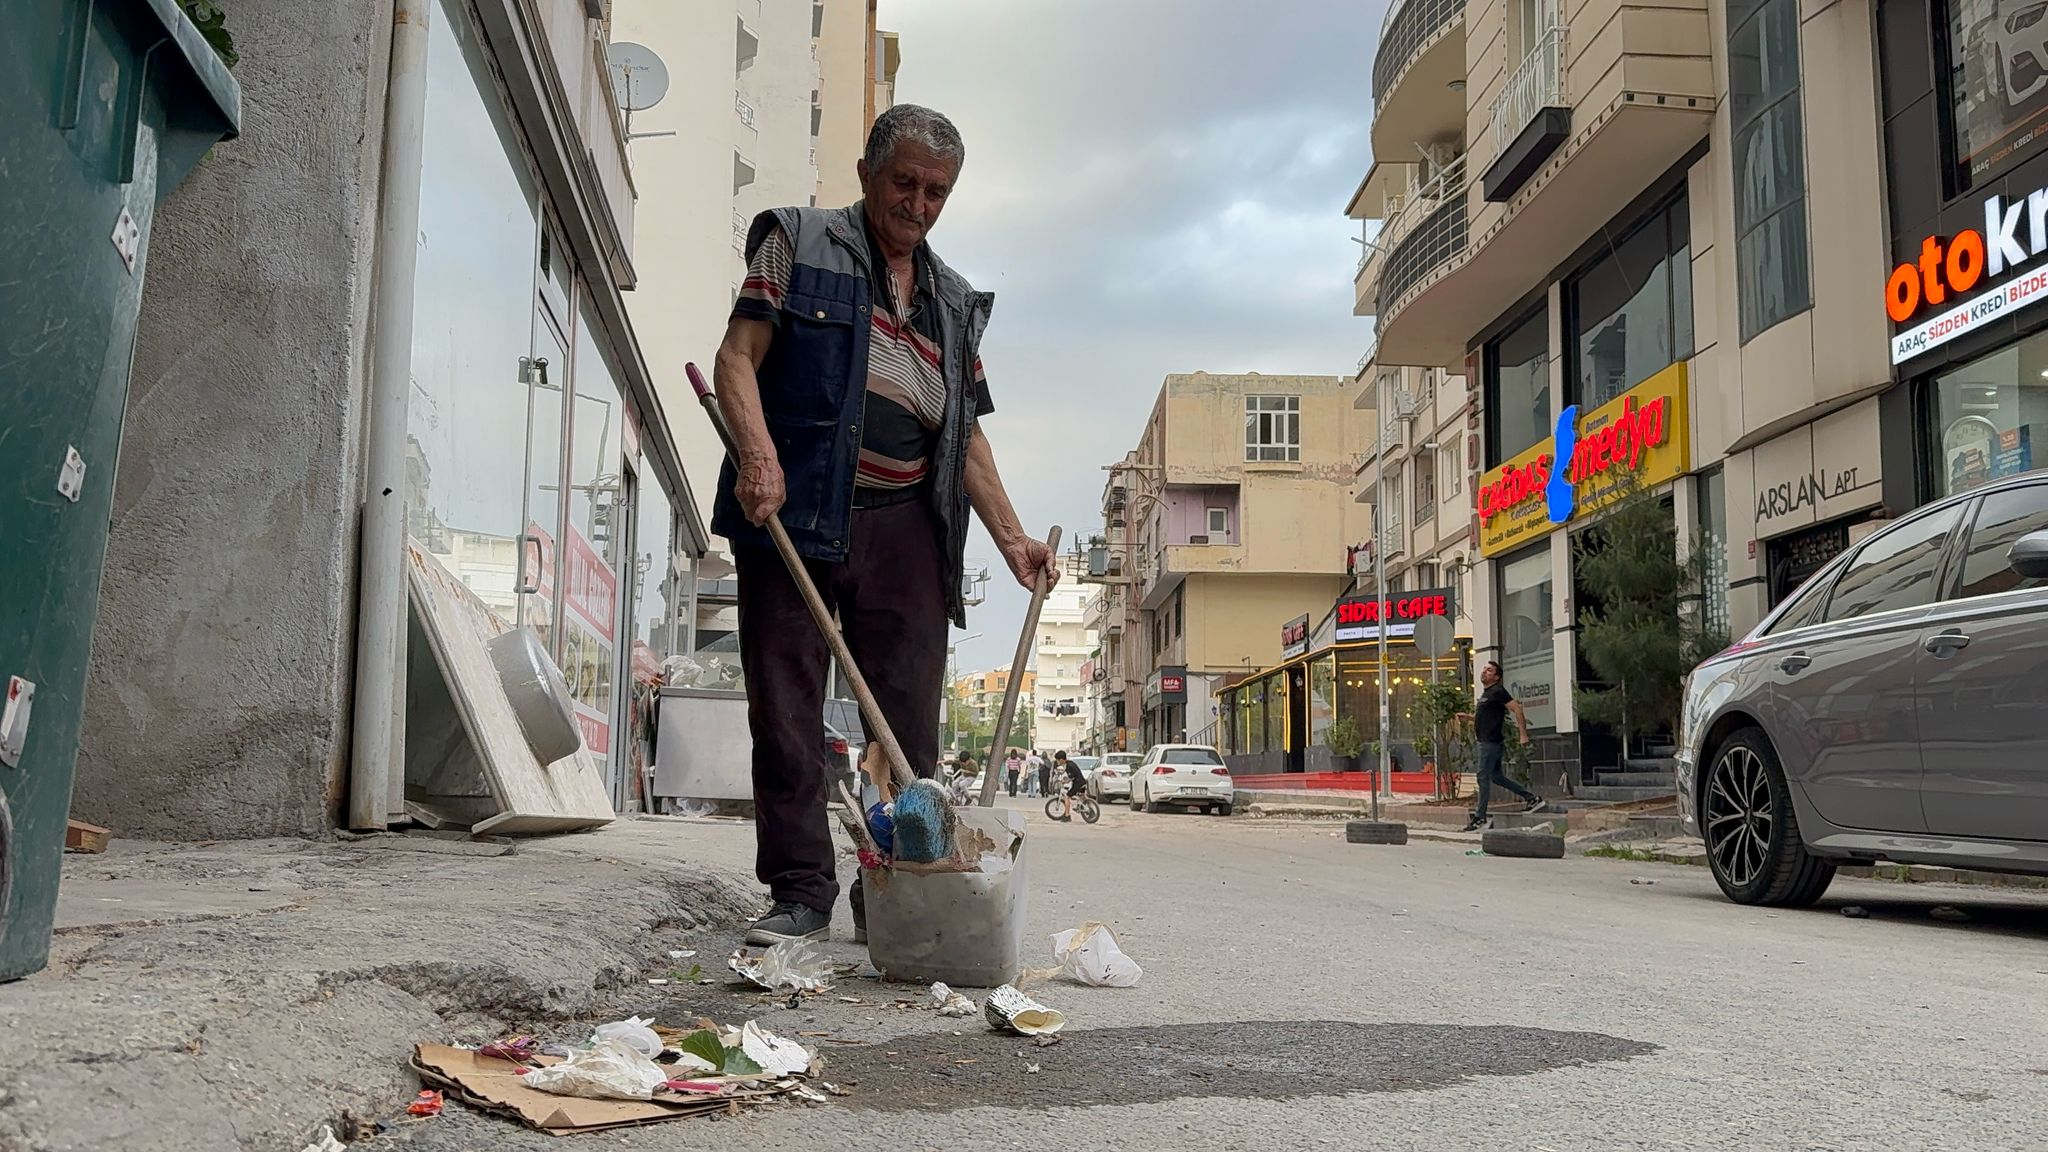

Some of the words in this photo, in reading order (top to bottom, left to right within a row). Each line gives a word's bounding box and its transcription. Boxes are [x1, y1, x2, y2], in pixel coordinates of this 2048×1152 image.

[1898, 331, 1928, 356] ARAÇ
[1928, 310, 1969, 341] SİZDEN
[1971, 287, 2008, 322] KREDİ
[1572, 394, 1665, 485] medya
[1755, 468, 1827, 524] ARSLAN
[1834, 467, 1858, 496] APT
[1397, 595, 1446, 619] CAFE
[1518, 682, 1550, 698] Matbaa
